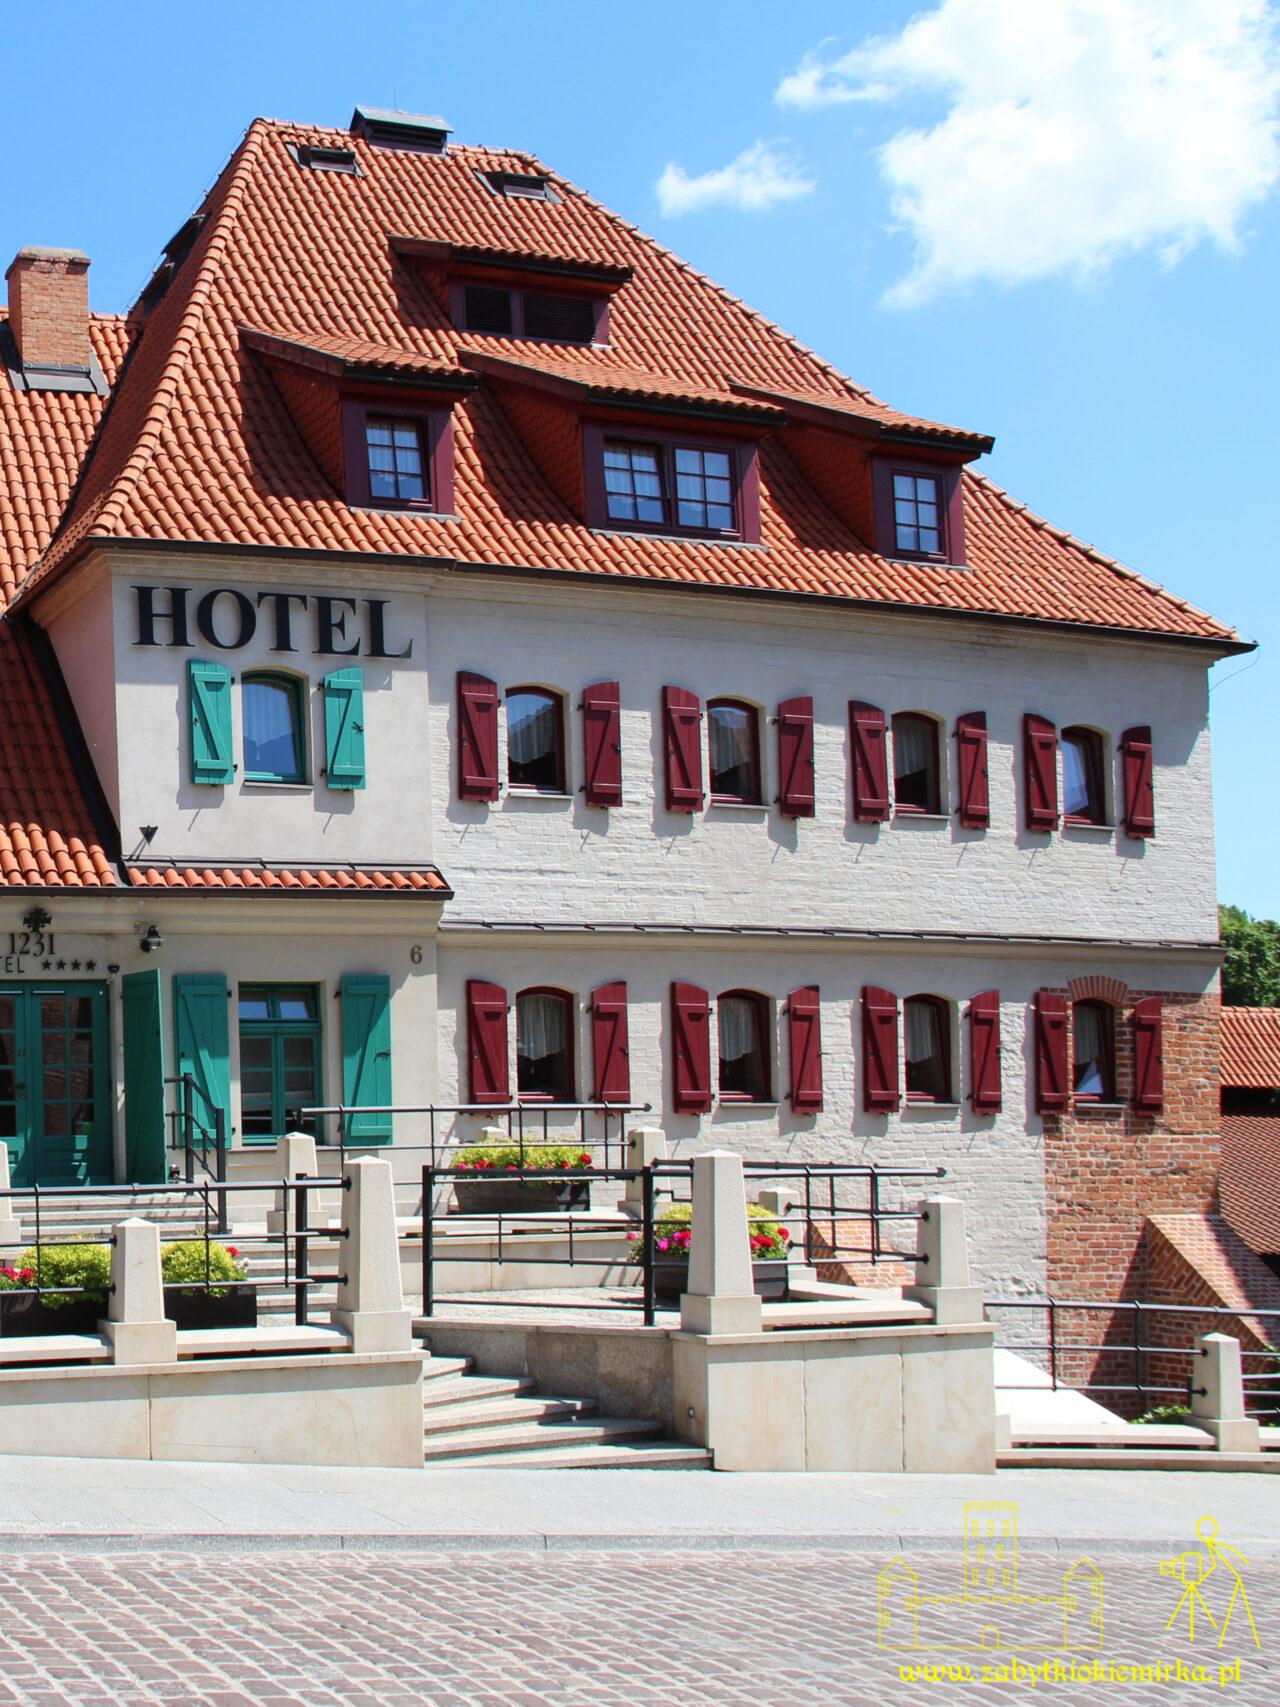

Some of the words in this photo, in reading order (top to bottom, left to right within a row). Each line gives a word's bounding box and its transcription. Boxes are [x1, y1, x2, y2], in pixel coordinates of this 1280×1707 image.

[130, 585, 412, 659] HOTEL
[9, 932, 56, 957] 1231
[410, 944, 422, 964] 6
